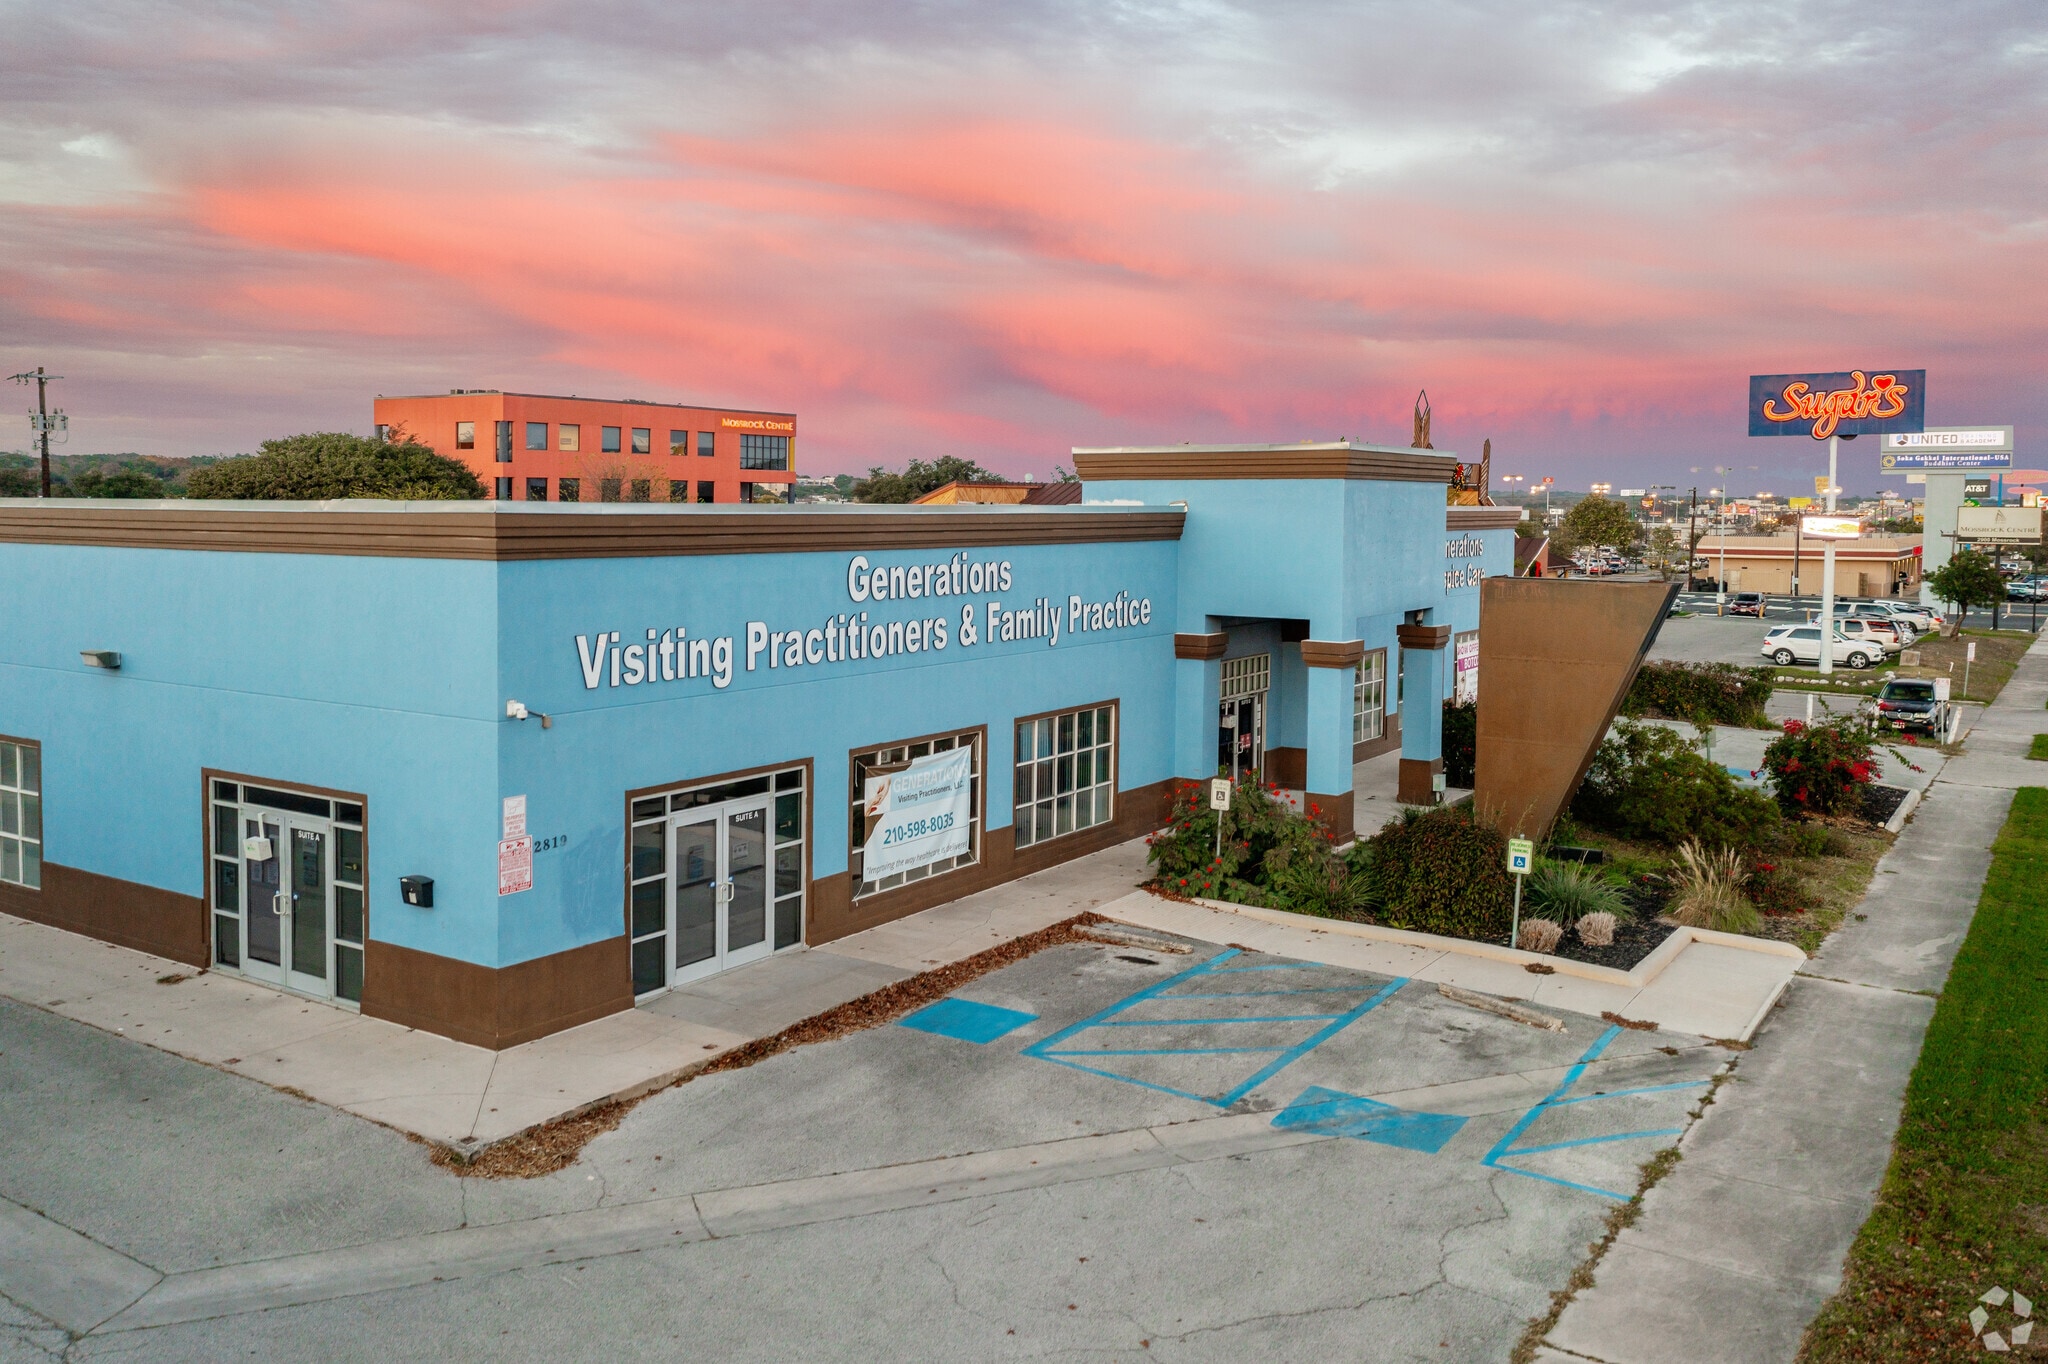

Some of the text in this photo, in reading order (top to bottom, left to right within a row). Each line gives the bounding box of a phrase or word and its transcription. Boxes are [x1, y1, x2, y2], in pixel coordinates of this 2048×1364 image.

[1911, 434, 1958, 444] UNITED
[848, 552, 1012, 602] Generations
[575, 590, 1151, 689] Visiting Practitioners & Family Practice
[893, 762, 969, 793] GENERATIONS
[898, 792, 918, 804] Visiting
[735, 811, 753, 822] SUITE
[298, 831, 314, 841] SUITE
[883, 811, 954, 845] 210-598-8035
[896, 857, 904, 866] the
[905, 855, 916, 866] way
[916, 848, 941, 861] healthcare
